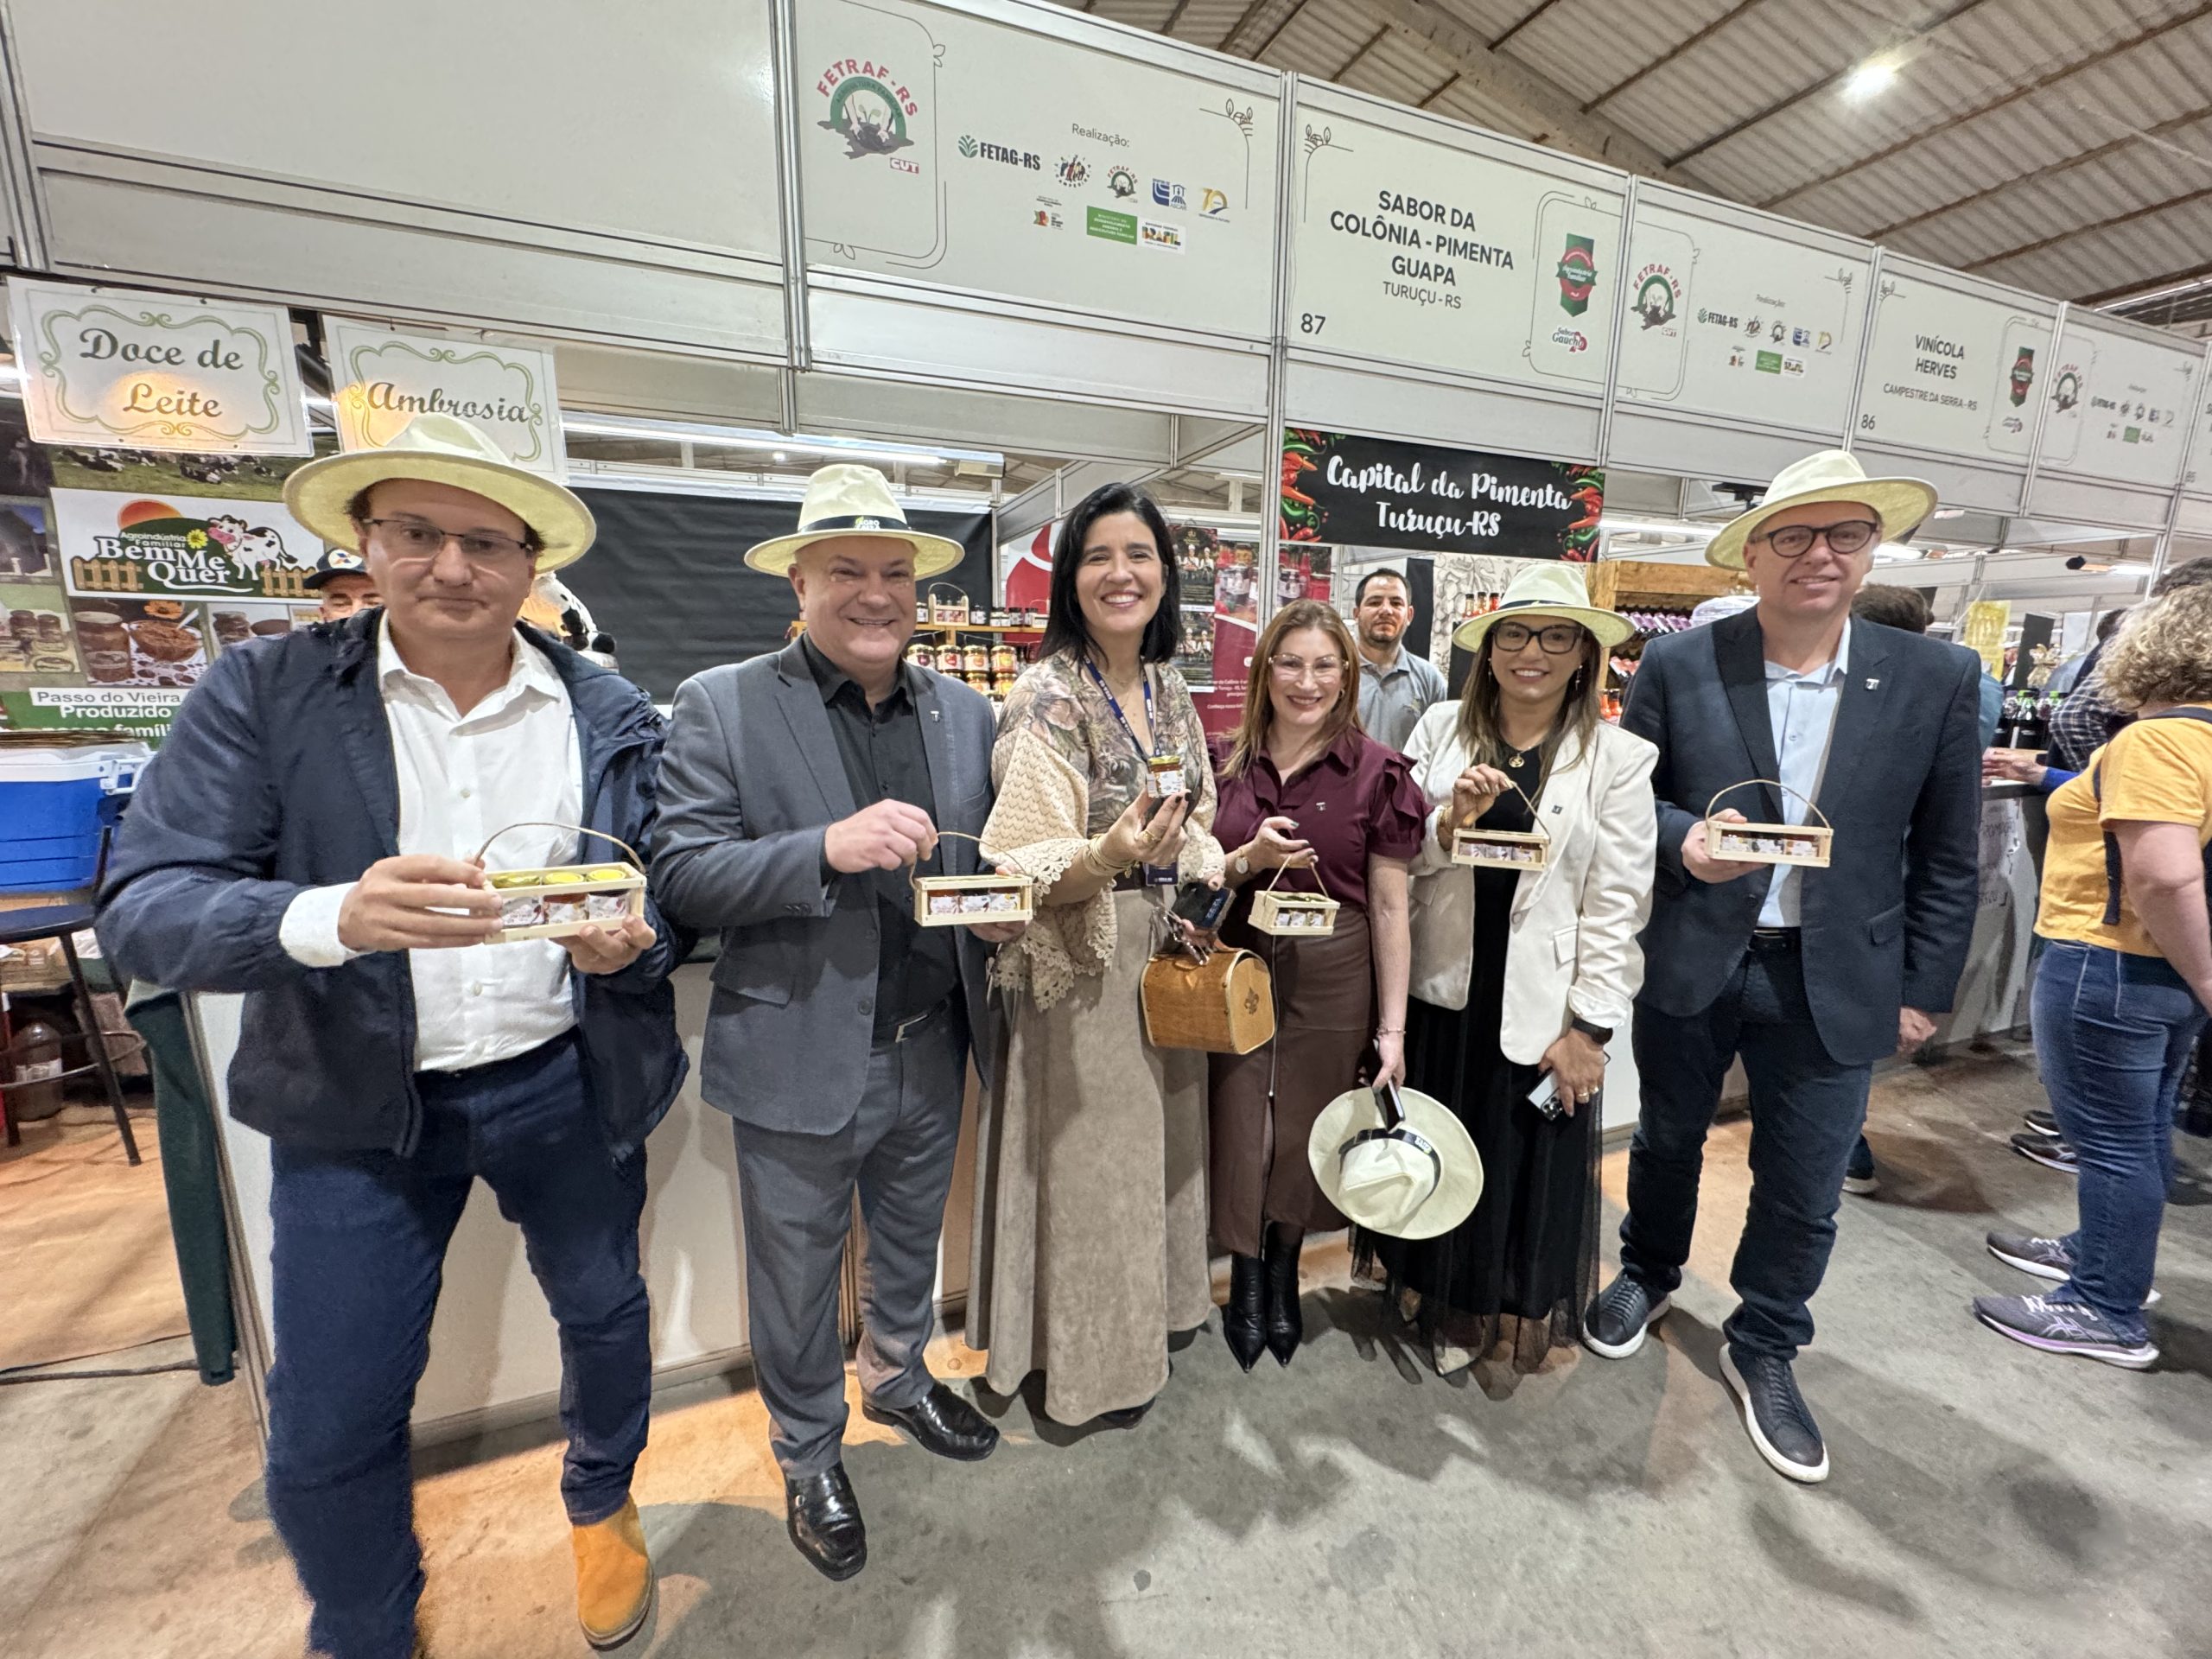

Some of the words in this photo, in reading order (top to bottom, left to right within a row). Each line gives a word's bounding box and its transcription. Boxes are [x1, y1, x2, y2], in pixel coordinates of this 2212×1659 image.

[1072, 124, 1130, 148] Realização:
[891, 159, 918, 173] CUT
[980, 142, 1041, 171] FETAG-RS
[1378, 190, 1446, 224] SABOR
[1451, 208, 1476, 232] DA
[1330, 210, 1421, 249] COLÔNIA
[1435, 234, 1514, 270] PIMENTA
[1391, 256, 1456, 286] GUAPA
[1300, 313, 1326, 334] 87
[1708, 312, 1738, 328] FETAG-RS
[79, 327, 186, 366] Doce
[197, 340, 244, 371] de
[1916, 334, 1964, 359] VINÍCOLA
[1915, 358, 1957, 379] HERVES
[123, 383, 223, 418] Leite
[367, 382, 530, 423] Ambrosia
[1884, 383, 1928, 402] CAMPESTRE
[1929, 392, 1939, 403] DA
[1940, 395, 1963, 409] SERRA
[1861, 414, 1876, 430] 86
[1326, 454, 1426, 495] Capital
[1430, 470, 1465, 500] da
[1471, 472, 1573, 511] Pimenta
[1376, 501, 1502, 540] Turuçu-RS
[98, 537, 177, 562] Bem
[121, 531, 188, 543] Agroindústria
[175, 549, 226, 570] Me
[147, 561, 232, 590] Quer
[38, 692, 95, 702] Passo
[101, 692, 124, 702] do
[127, 692, 181, 702] Vieira
[60, 704, 172, 718] Produzido
